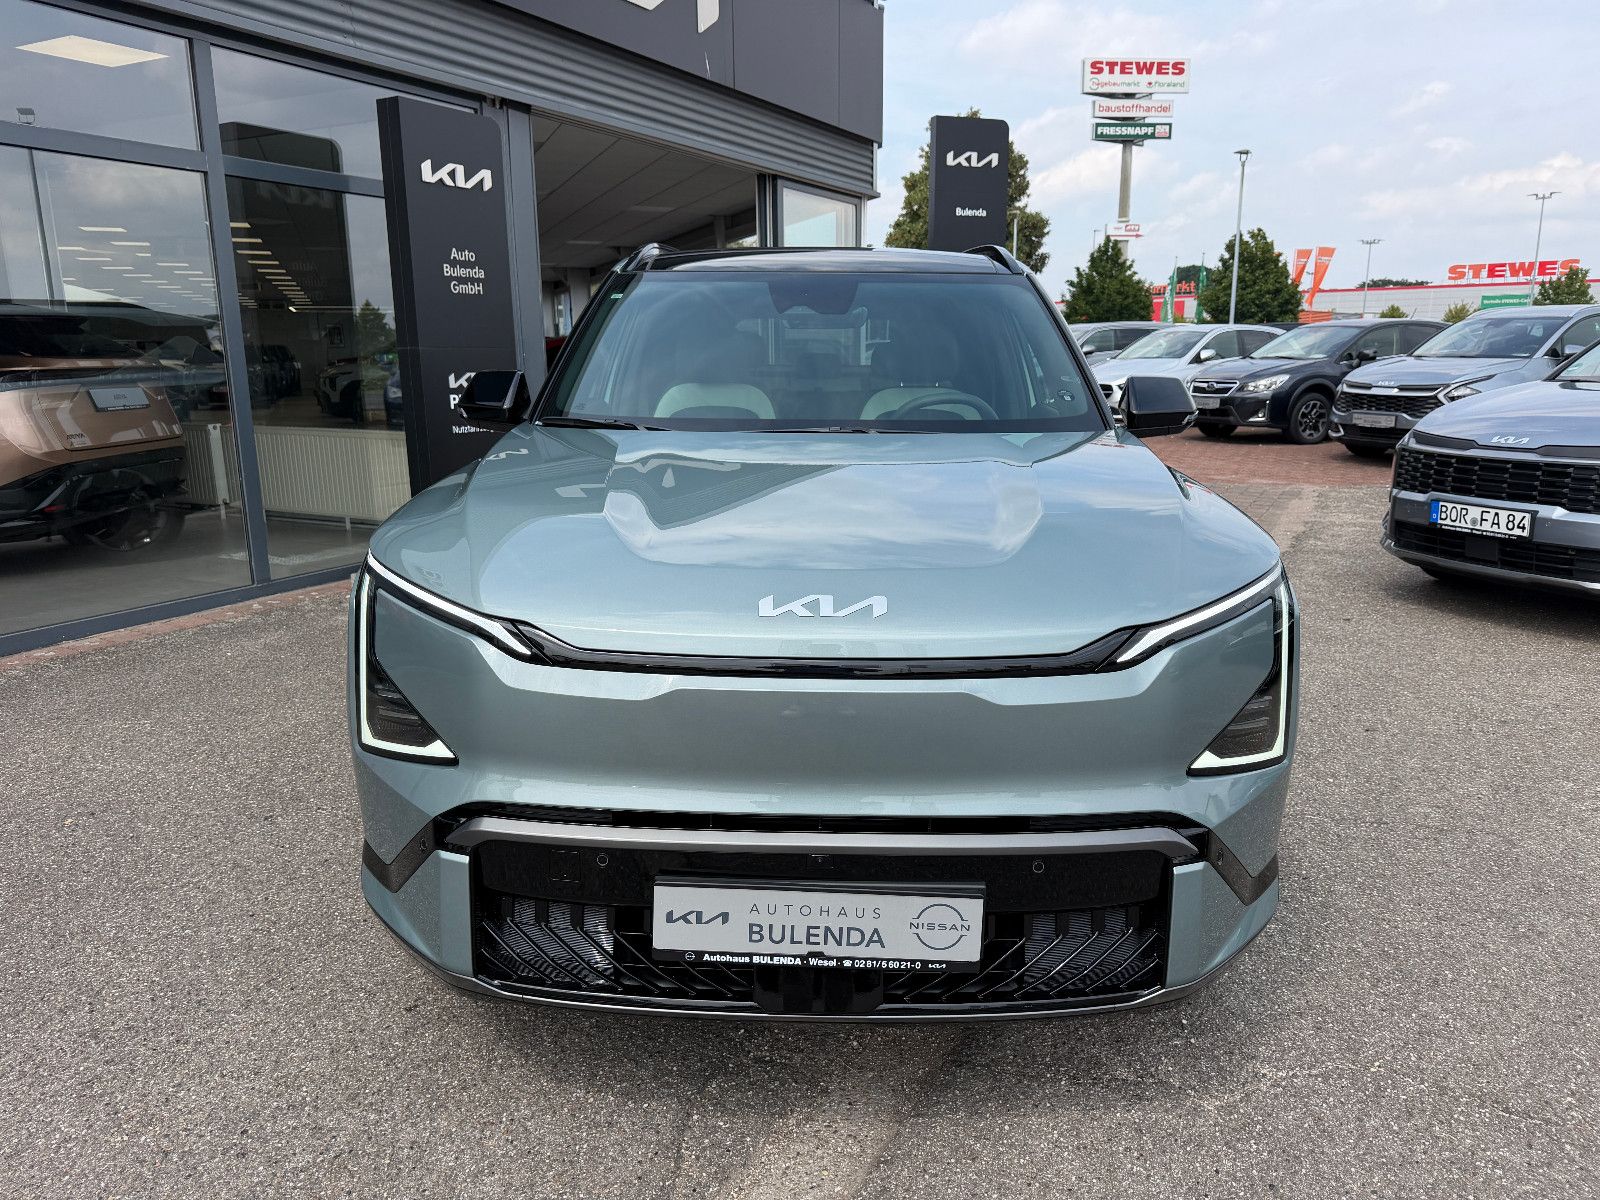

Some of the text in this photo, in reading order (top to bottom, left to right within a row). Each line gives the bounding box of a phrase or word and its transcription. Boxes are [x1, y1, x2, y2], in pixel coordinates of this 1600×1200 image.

[1090, 60, 1186, 76] STEWES
[1098, 103, 1171, 113] baustoffhandel
[1097, 126, 1154, 135] FRESSNAPF
[946, 150, 999, 168] KIA
[421, 158, 493, 192] KIA
[955, 206, 987, 217] Bulenda
[450, 247, 476, 262] Auto
[443, 263, 485, 279] Bulenda
[1447, 258, 1581, 281] STEWES
[450, 280, 484, 295] GmbH
[1439, 504, 1469, 525] BOR
[1479, 510, 1501, 530] FA
[1505, 513, 1527, 533] 84
[758, 594, 888, 619] KIA
[665, 909, 730, 925] KIA
[749, 902, 882, 920] AUTOHAUS
[909, 921, 971, 932] NISSAN
[747, 922, 886, 949] BULENDA
[702, 953, 751, 964] Autohaus
[752, 955, 802, 966] BULENDA
[808, 957, 837, 967] Wesel
